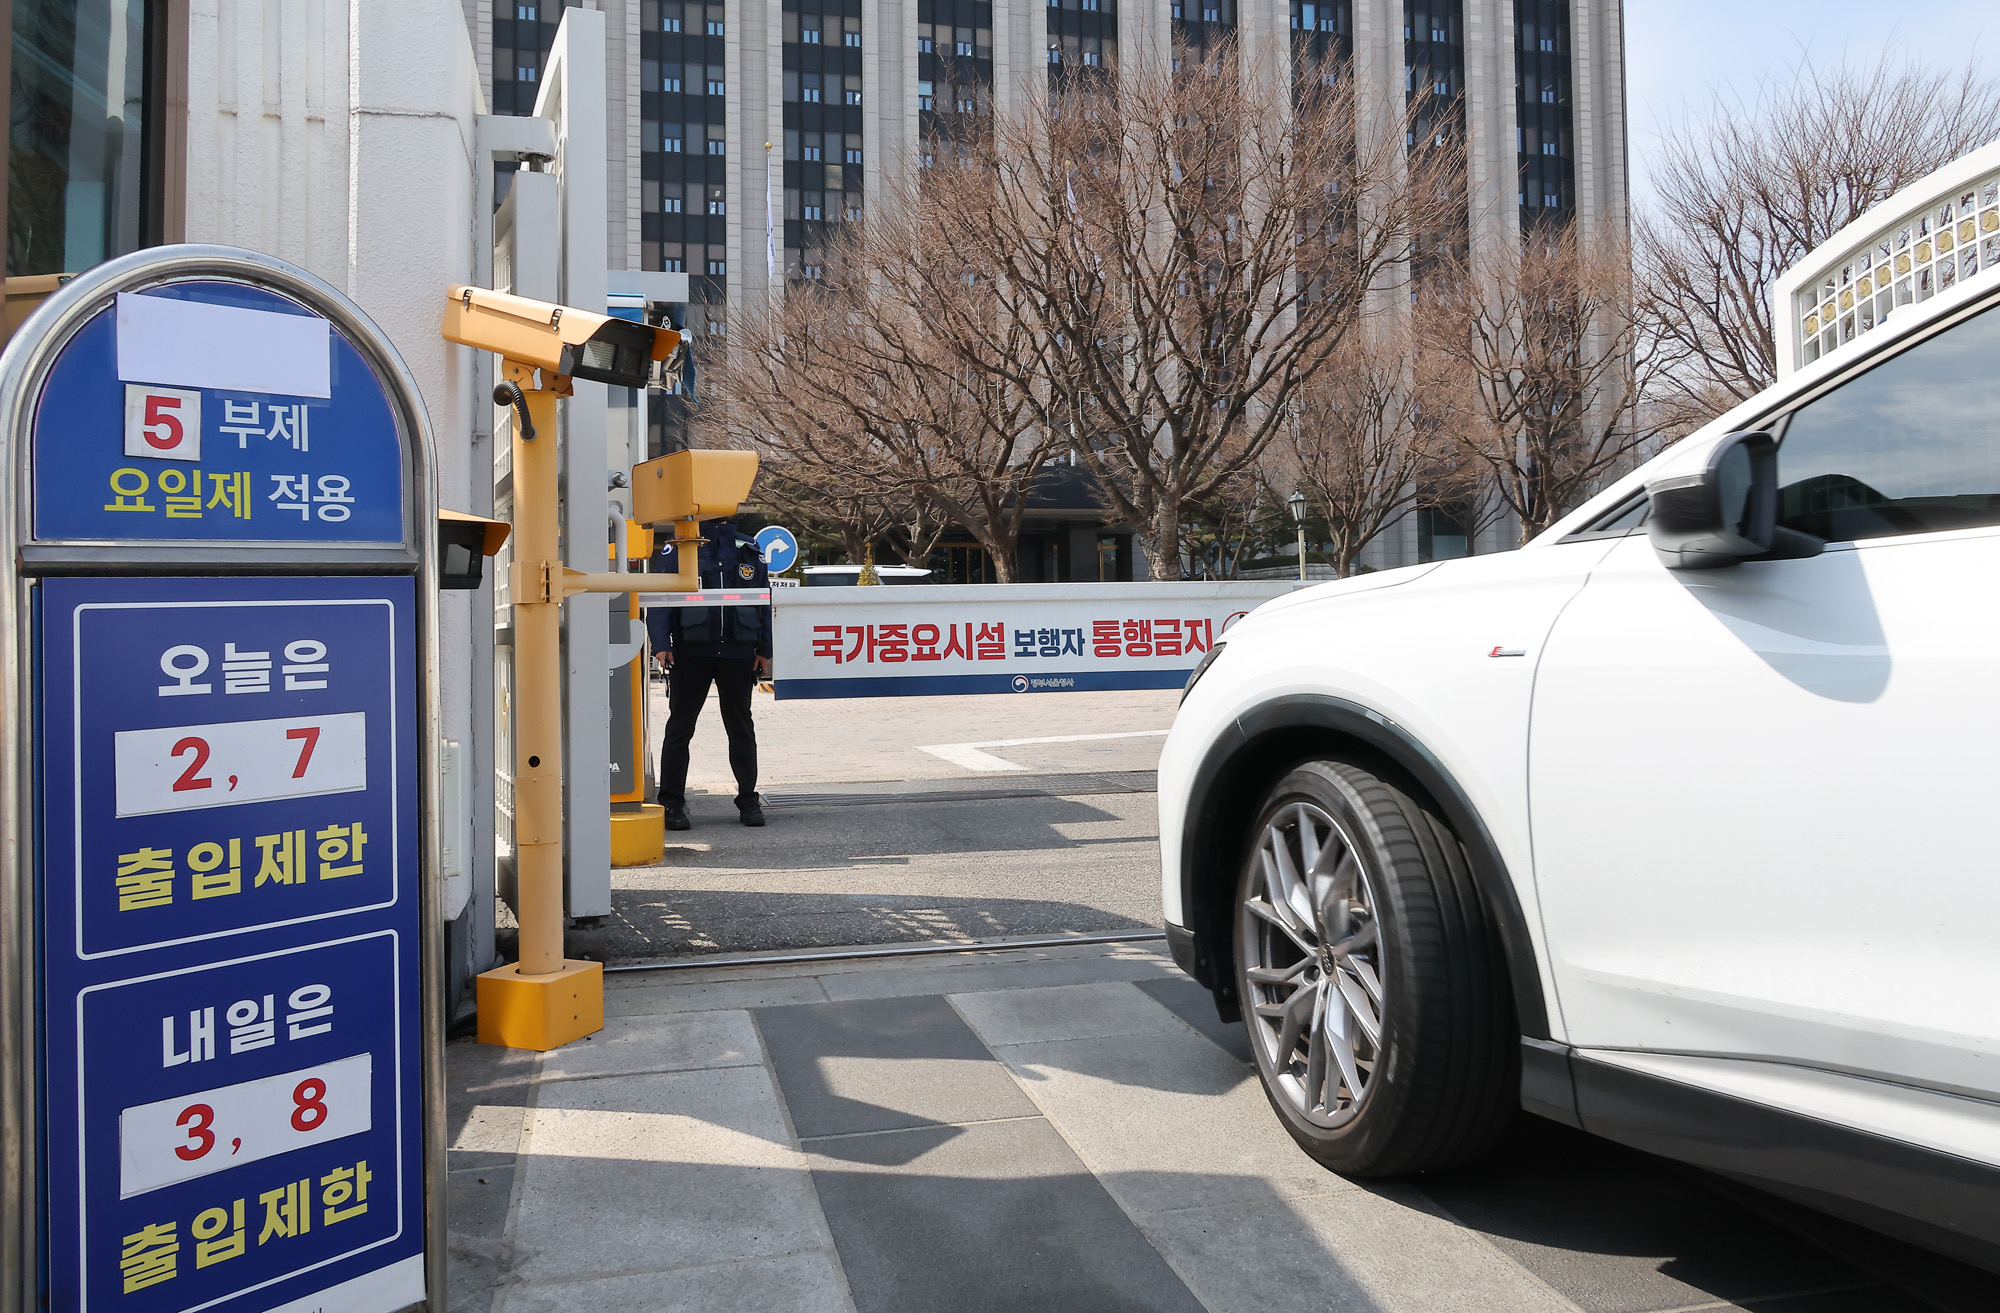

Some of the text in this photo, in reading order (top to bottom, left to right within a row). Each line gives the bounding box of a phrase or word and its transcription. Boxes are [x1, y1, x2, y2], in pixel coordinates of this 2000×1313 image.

[144, 396, 309, 452] 5 부제
[104, 467, 355, 522] 요일제 적용
[158, 640, 330, 697] 오늘은
[813, 619, 1213, 664] 국가중요시설 보행자 통행금지
[286, 727, 320, 779] 7
[115, 822, 368, 912] 출입제한
[162, 984, 334, 1068] 내일은
[290, 1078, 328, 1132] 8
[120, 1160, 372, 1294] 출입제한
